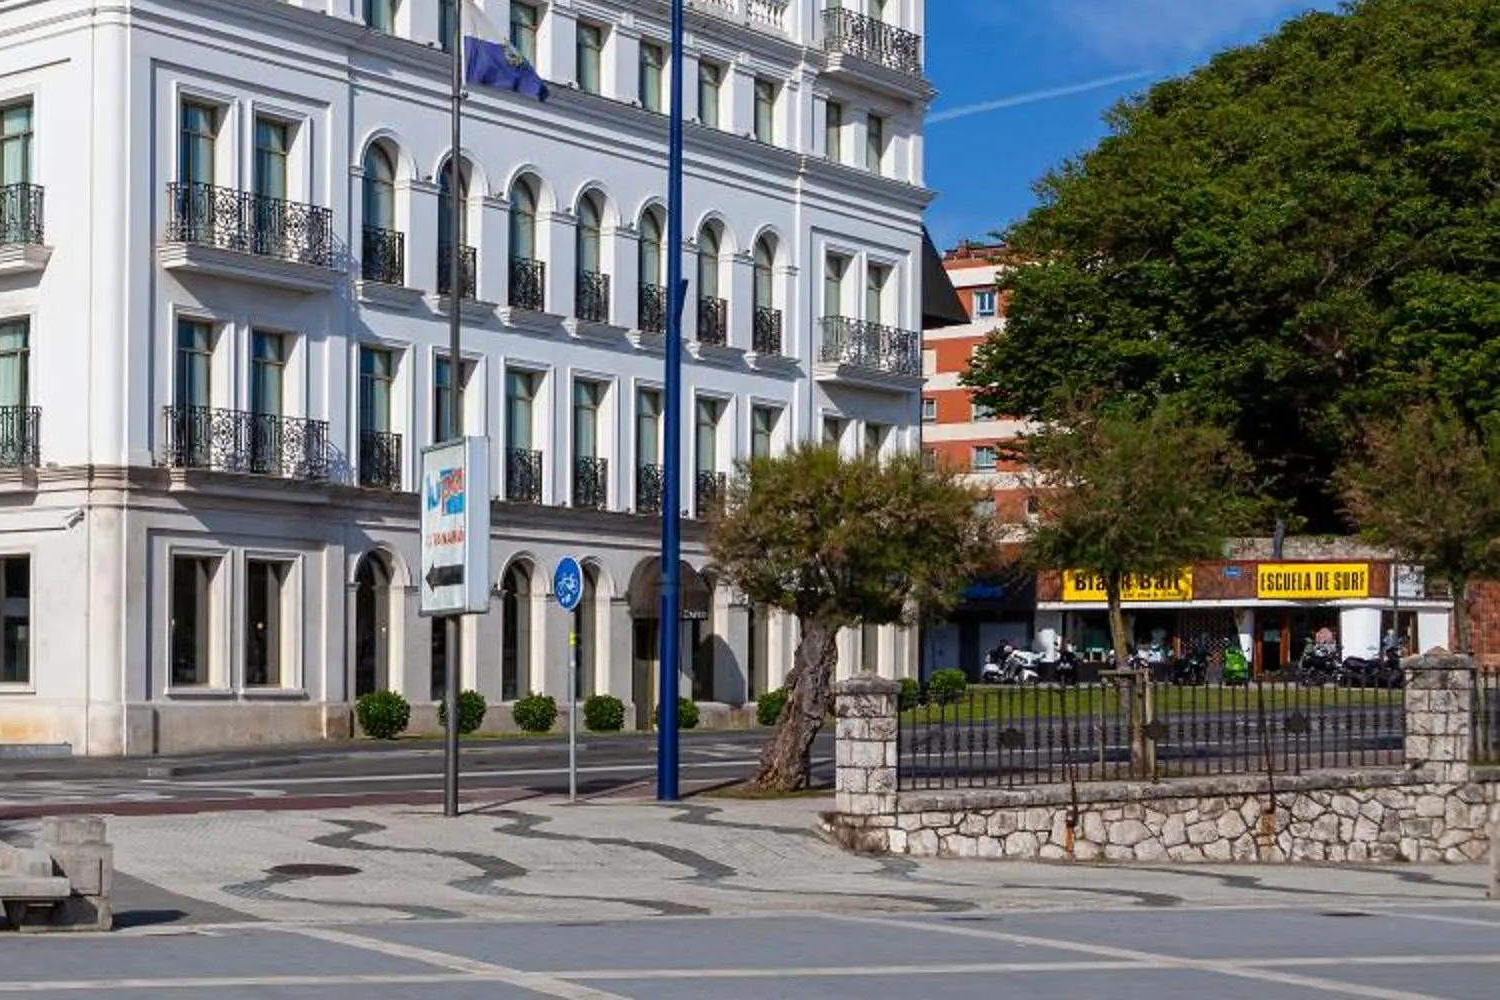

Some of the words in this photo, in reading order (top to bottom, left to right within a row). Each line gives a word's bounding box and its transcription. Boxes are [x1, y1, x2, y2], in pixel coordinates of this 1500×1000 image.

[1260, 572, 1312, 592] ESCUELA
[1315, 572, 1329, 591] DE
[1333, 571, 1365, 591] SURF
